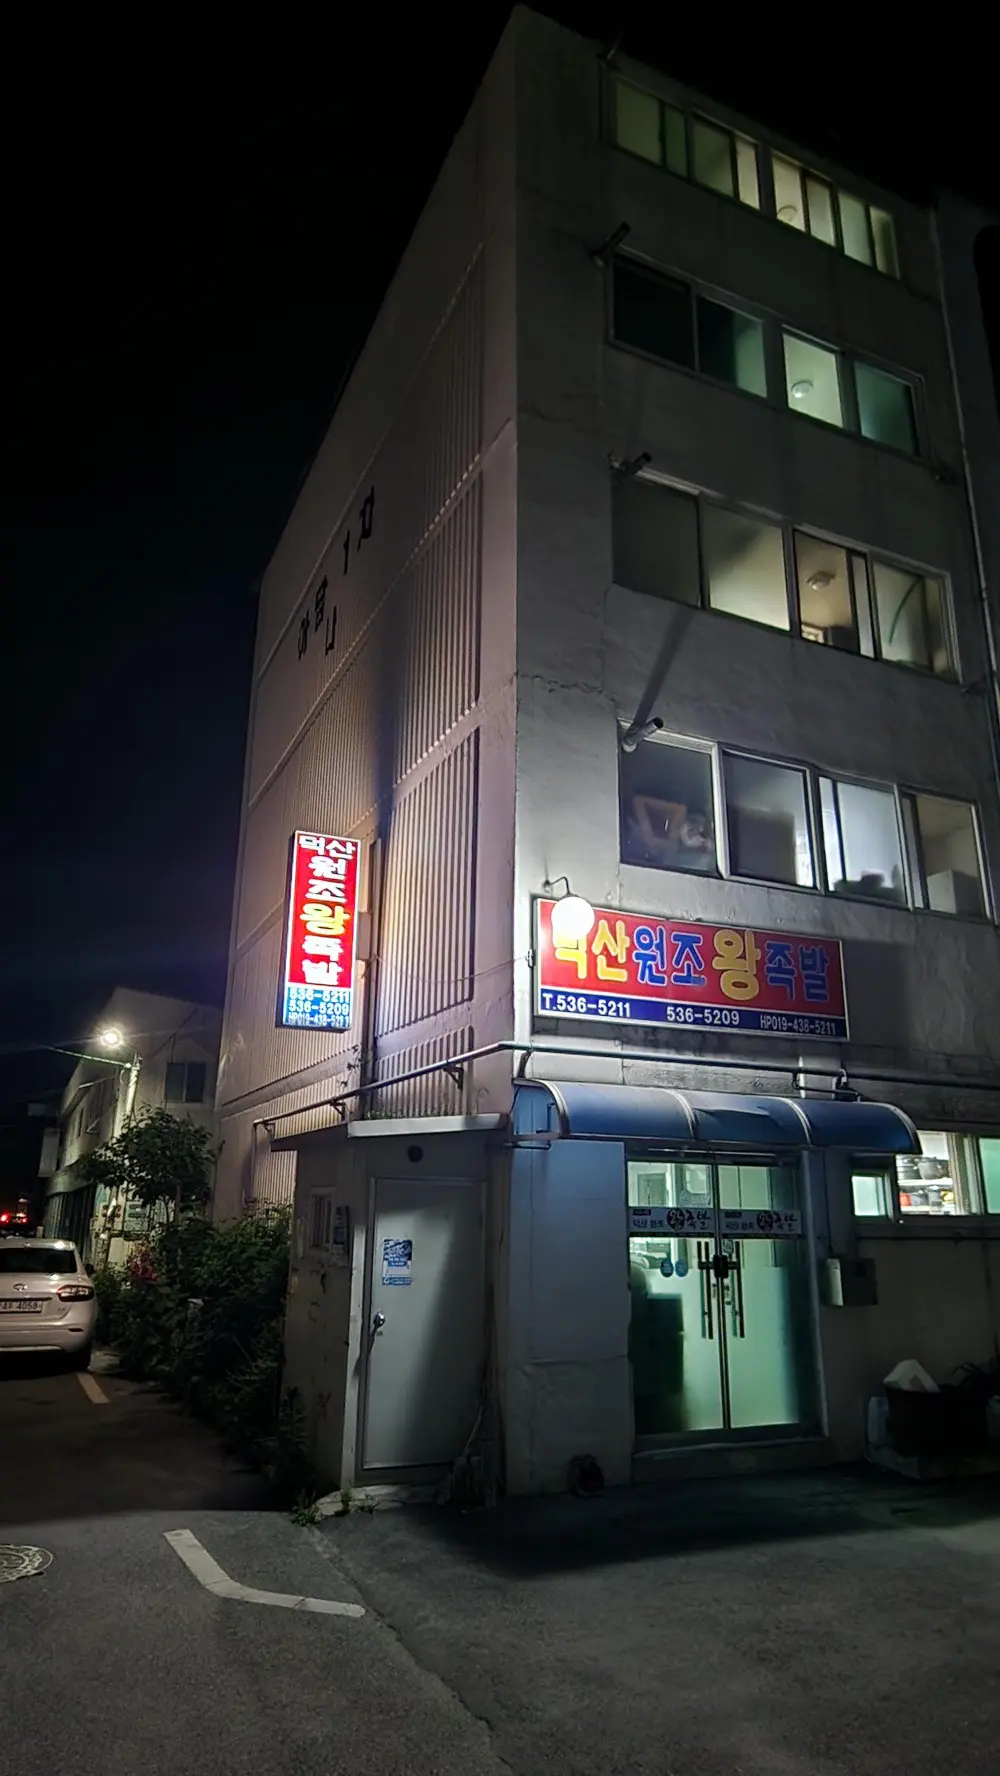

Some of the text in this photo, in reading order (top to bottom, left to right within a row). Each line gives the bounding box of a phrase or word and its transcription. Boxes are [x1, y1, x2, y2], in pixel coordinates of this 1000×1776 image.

[289, 987, 350, 1003] 536-5211
[289, 1000, 349, 1016] 536-5209
[542, 993, 836, 1035] T.536-5211 536-5209 HP019-438-5211
